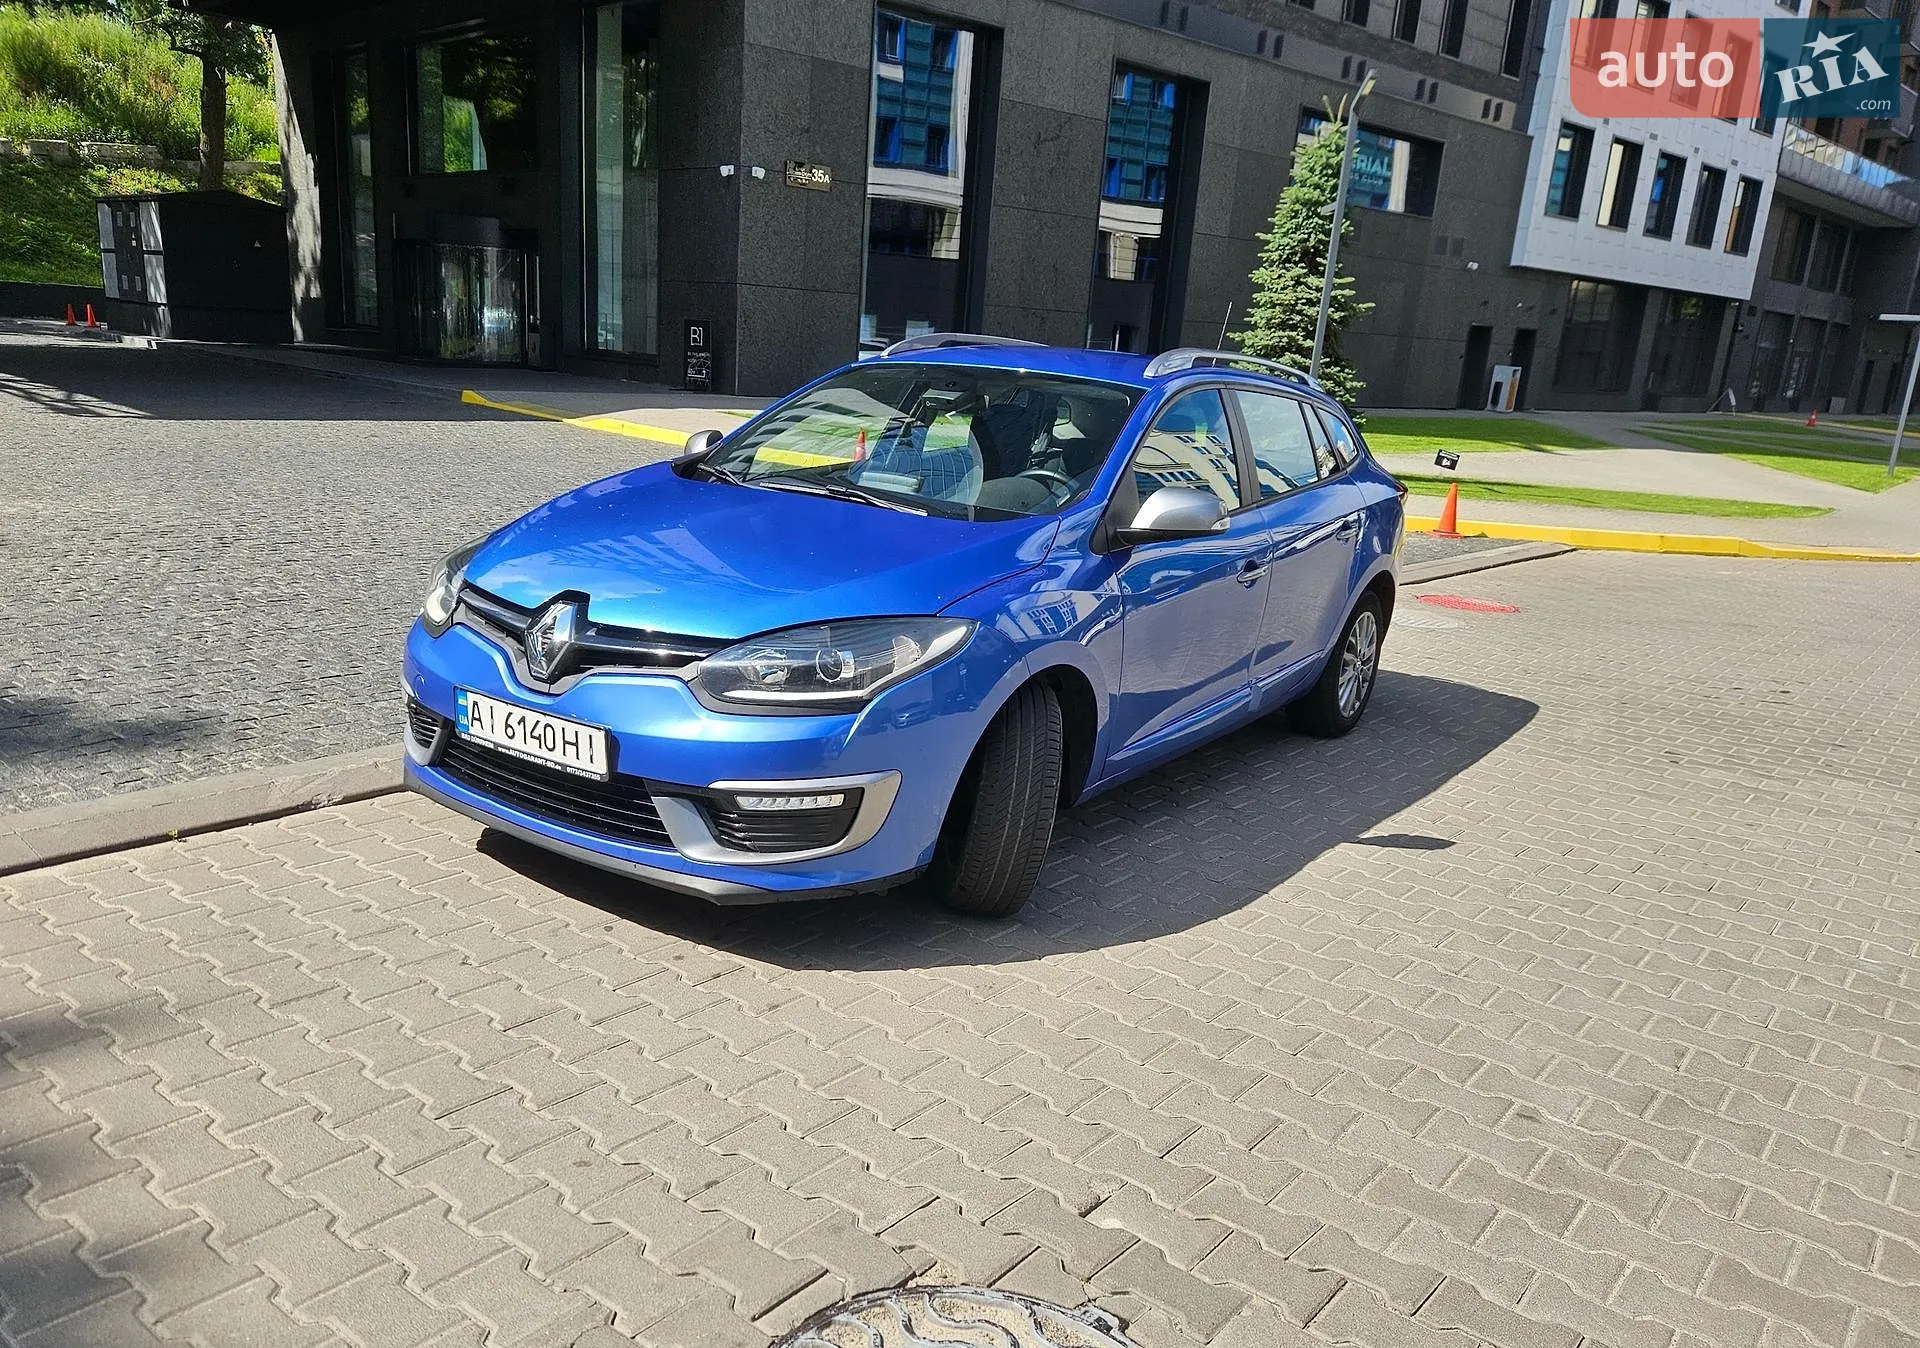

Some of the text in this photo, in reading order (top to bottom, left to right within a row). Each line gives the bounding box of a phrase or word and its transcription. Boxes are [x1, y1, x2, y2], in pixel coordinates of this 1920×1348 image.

[459, 714, 469, 726] UA
[470, 700, 594, 764] AI 6140 HI
